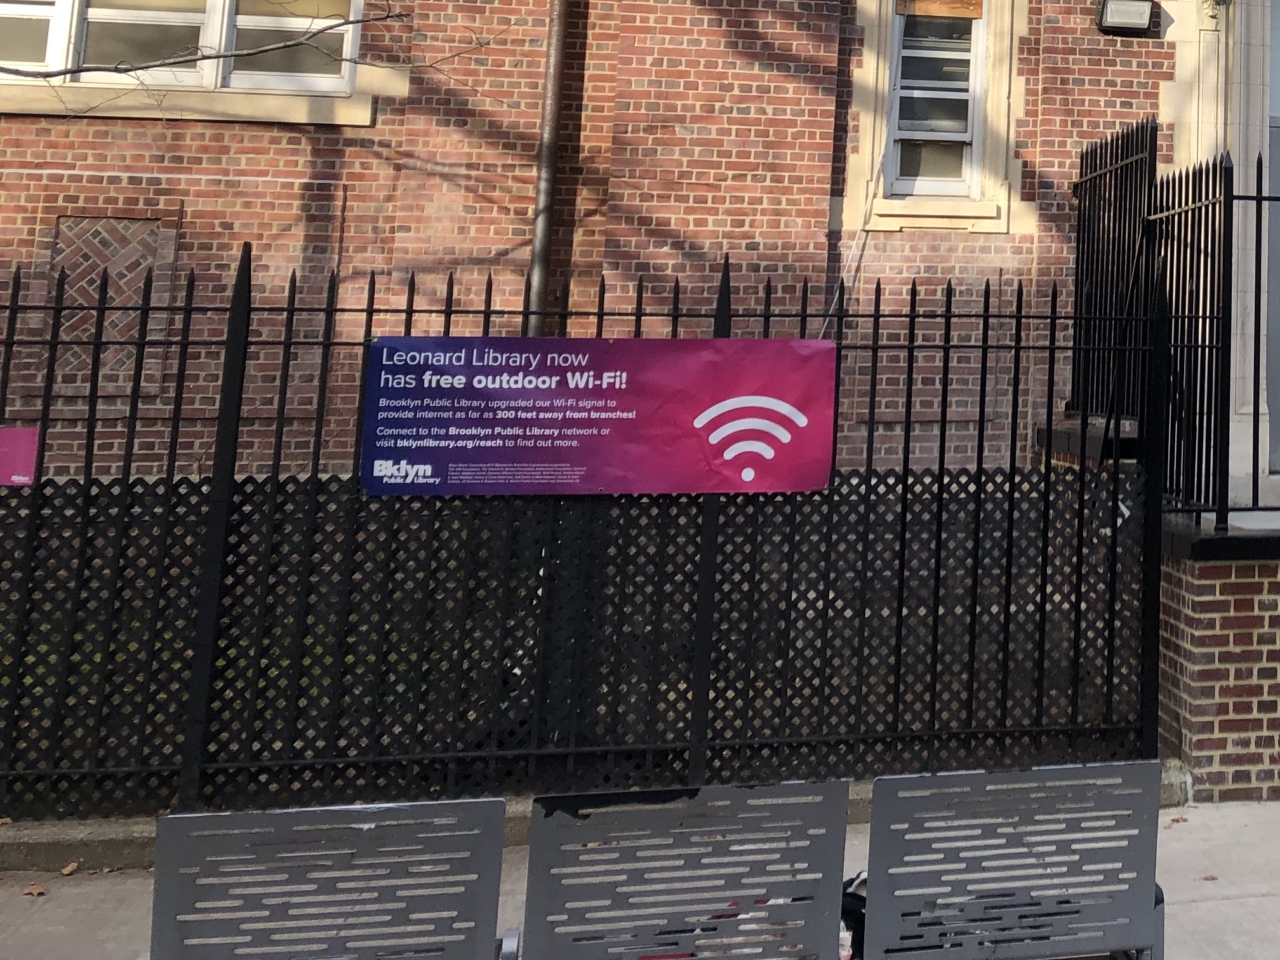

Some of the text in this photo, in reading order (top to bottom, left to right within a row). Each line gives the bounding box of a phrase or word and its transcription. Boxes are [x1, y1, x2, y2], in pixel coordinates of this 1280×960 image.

[382, 348, 589, 371] Leonard Library now
[380, 370, 628, 389] has free outdoor Wi-Fi!
[379, 398, 421, 409] Brooklyn
[423, 398, 452, 407] Public
[454, 399, 486, 409] Library
[488, 399, 533, 409] upgraded
[553, 399, 576, 408] Wi-Fi
[578, 399, 605, 409] signal
[607, 399, 617, 407] to
[378, 409, 414, 420] provide
[416, 410, 453, 419] internet
[455, 411, 466, 419] as
[468, 410, 480, 419] far
[496, 411, 515, 419] 300
[517, 410, 537, 419] feet
[539, 412, 564, 420] away
[565, 410, 588, 419] from
[590, 410, 636, 419] branches!
[376, 426, 416, 436] Connect
[419, 427, 429, 436] to
[431, 427, 446, 436] the
[448, 427, 492, 437] Brooklyn
[494, 426, 524, 436] Public
[526, 426, 559, 437] Library
[561, 427, 598, 435] network
[375, 438, 394, 448] visit
[397, 438, 503, 449] bklynlibrary.org/reach
[505, 439, 515, 447] to
[517, 438, 535, 447] find
[536, 439, 552, 447] out
[373, 459, 433, 484] Bklyn
[383, 476, 404, 484] Public
[414, 476, 441, 485] Library
